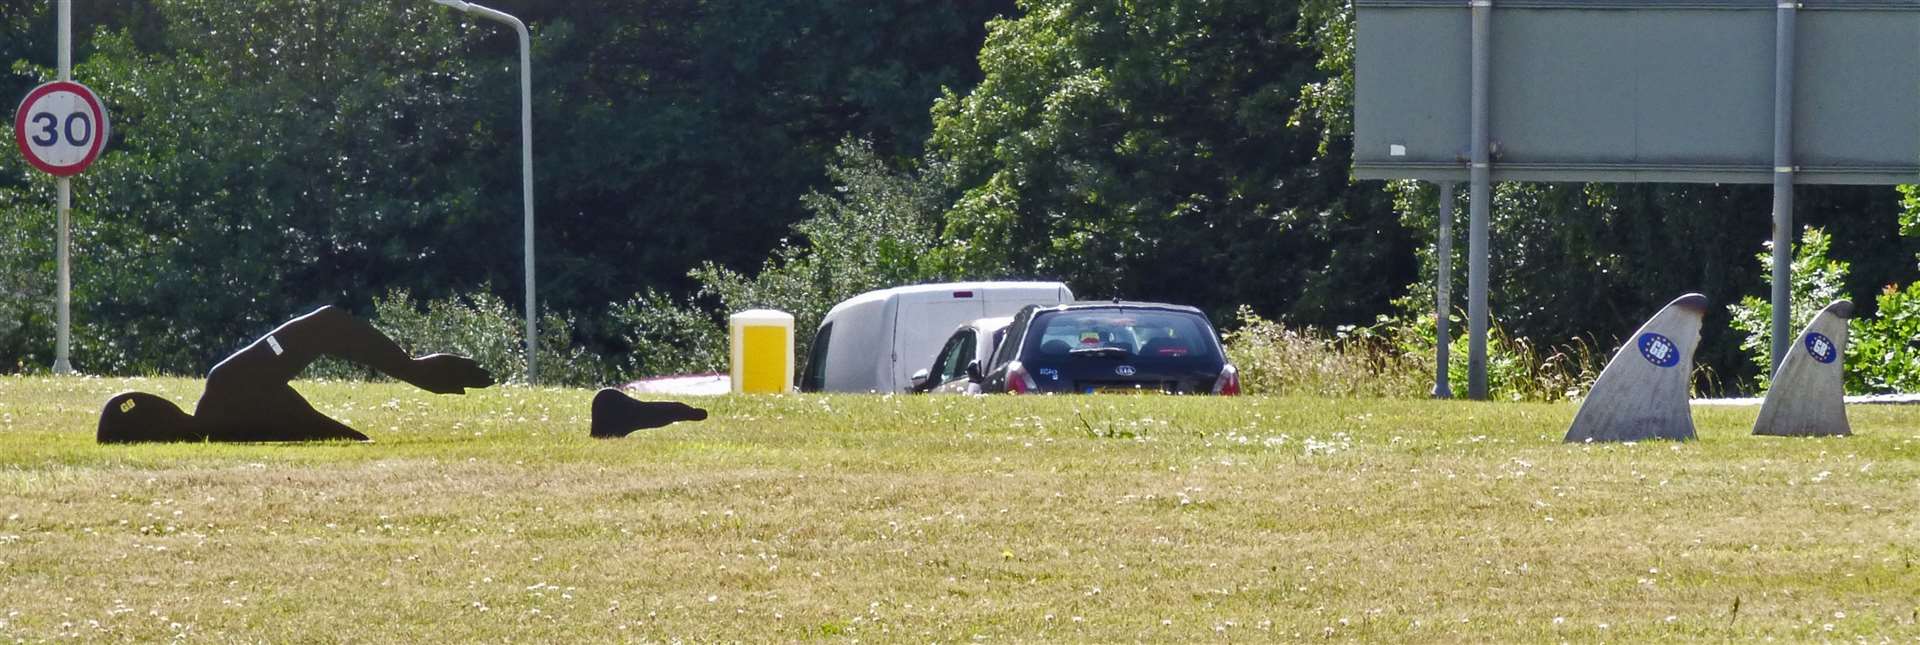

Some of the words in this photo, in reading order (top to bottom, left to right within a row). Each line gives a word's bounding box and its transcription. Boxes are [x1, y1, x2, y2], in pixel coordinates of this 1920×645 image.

[32, 112, 91, 147] 30
[1650, 340, 1668, 360] GB
[1813, 339, 1828, 357] GB
[120, 398, 136, 413] GB
